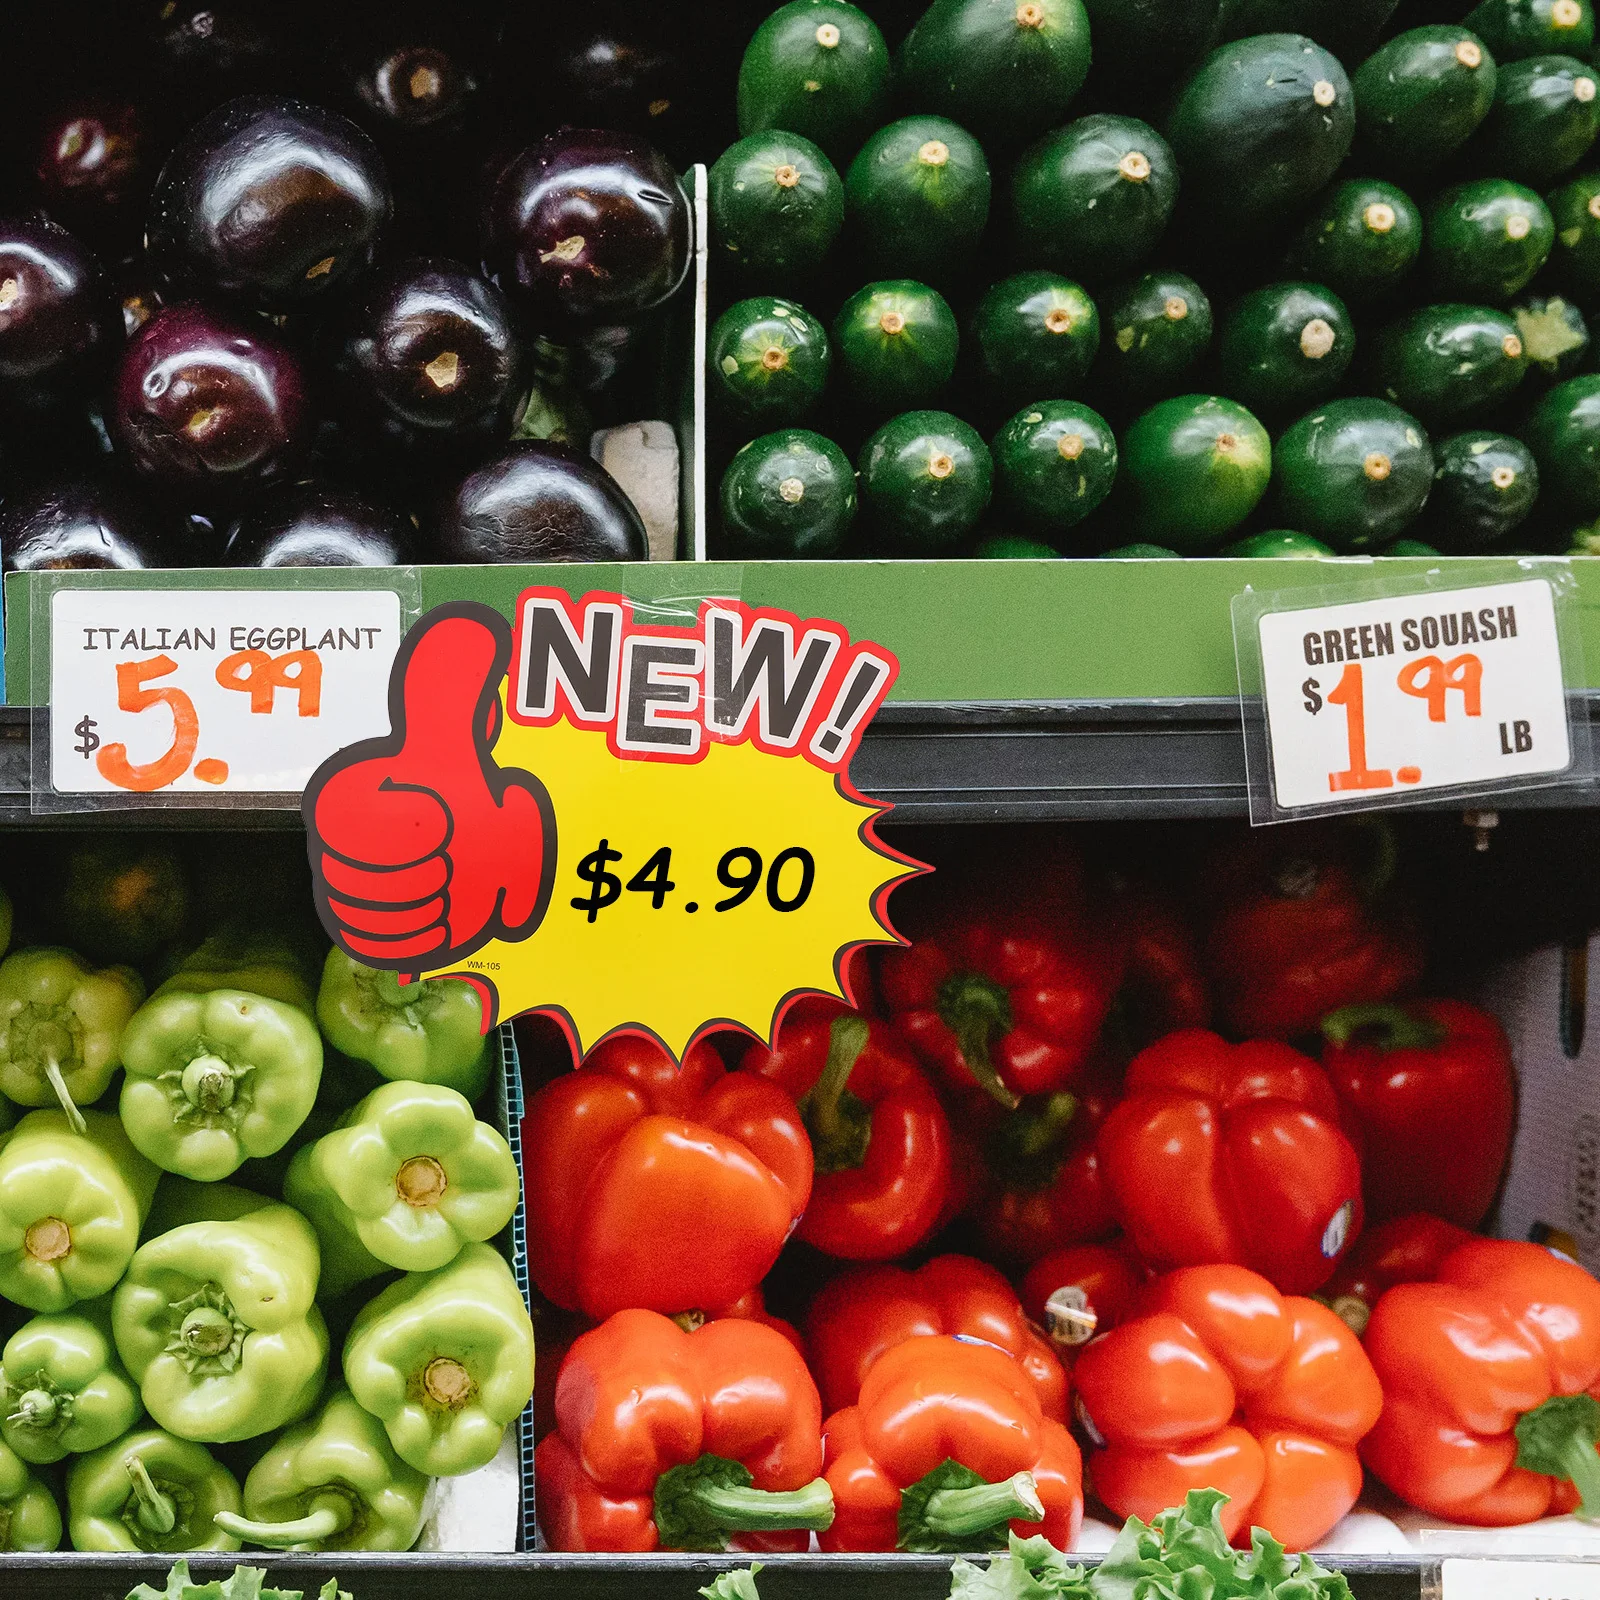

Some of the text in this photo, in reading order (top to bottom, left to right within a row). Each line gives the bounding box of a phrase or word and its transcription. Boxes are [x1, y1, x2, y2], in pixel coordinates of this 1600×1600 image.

[83, 626, 382, 651] ITALIAN EGGPLANT
[1303, 622, 1396, 666] GREEN
[517, 597, 890, 764] NEW!
[1499, 720, 1533, 755] LB
[570, 838, 815, 924] $4.90
[466, 960, 501, 971] WM-105
